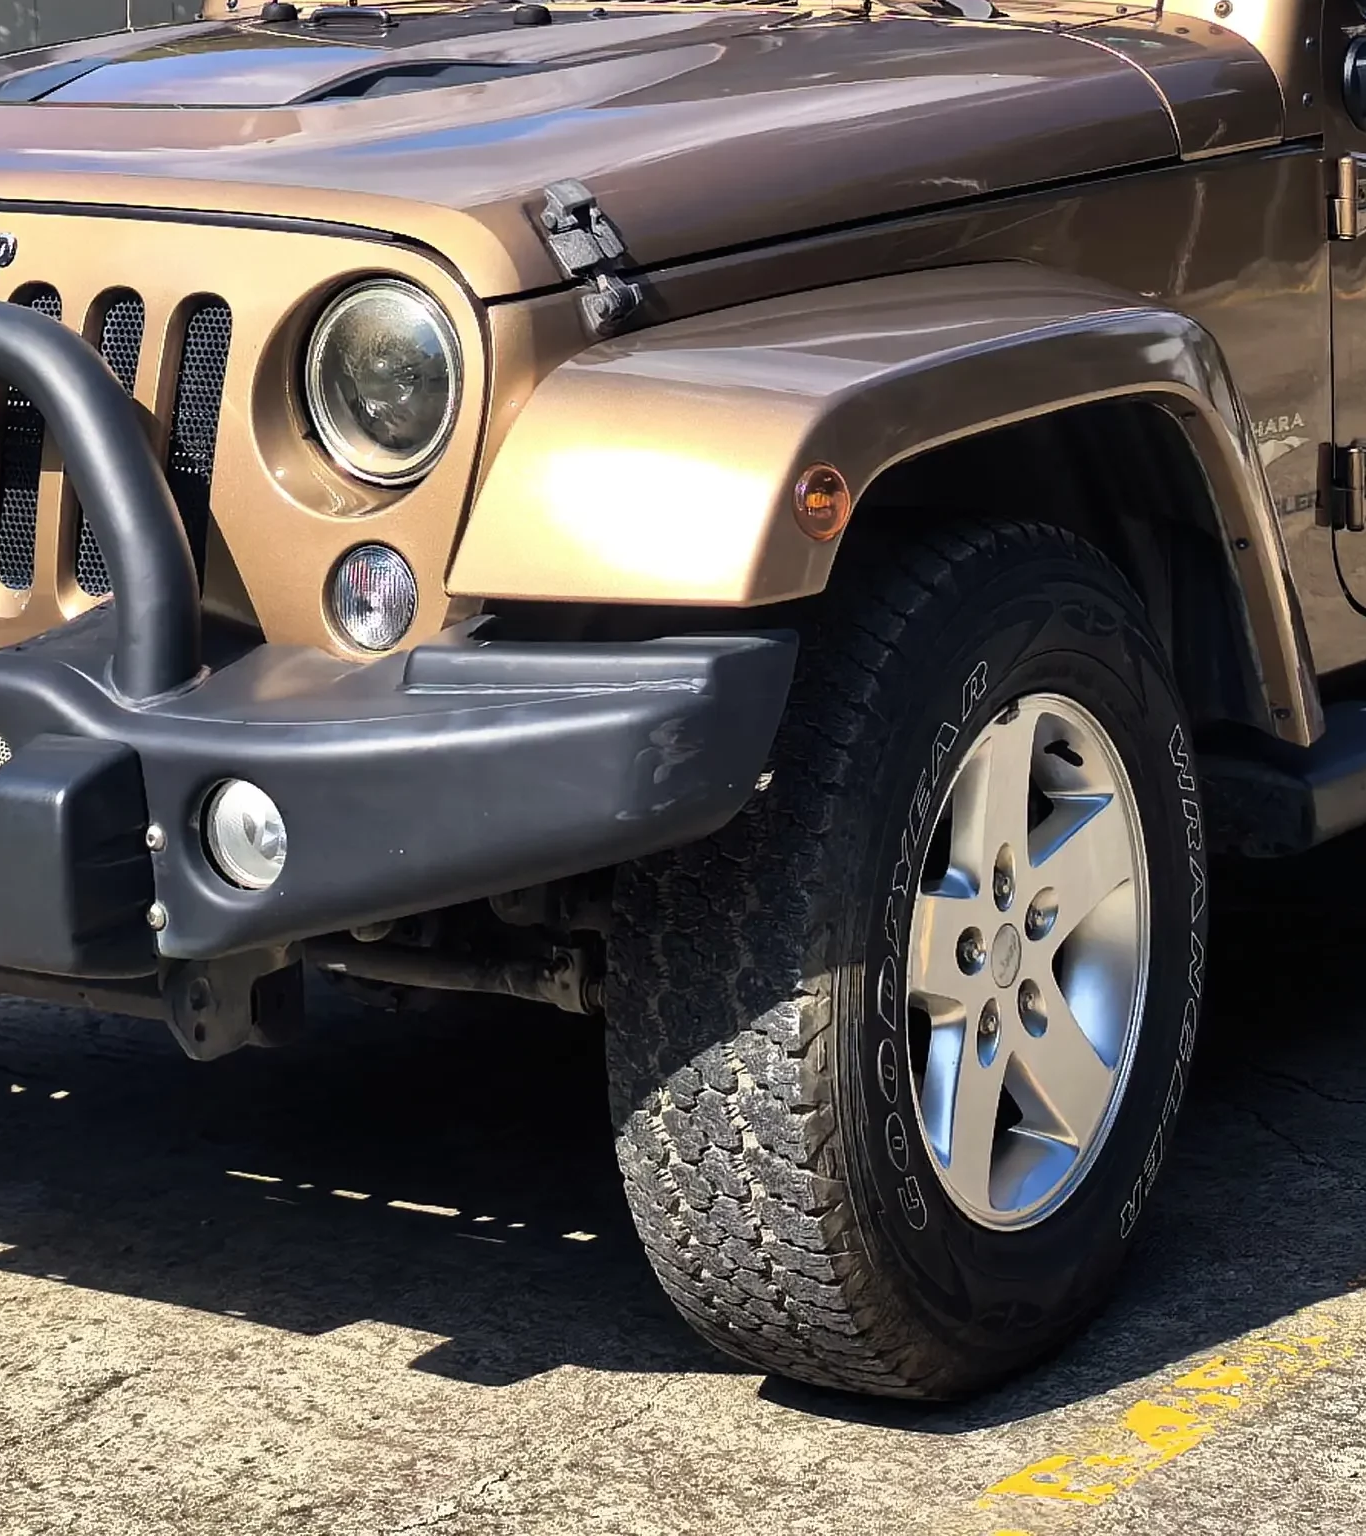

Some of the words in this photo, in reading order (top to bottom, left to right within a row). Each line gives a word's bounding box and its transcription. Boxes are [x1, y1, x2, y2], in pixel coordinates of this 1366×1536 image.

[1250, 412, 1306, 437] HARA
[877, 660, 989, 1231] GOODYEAR
[1119, 722, 1206, 1240] WRANGLER
